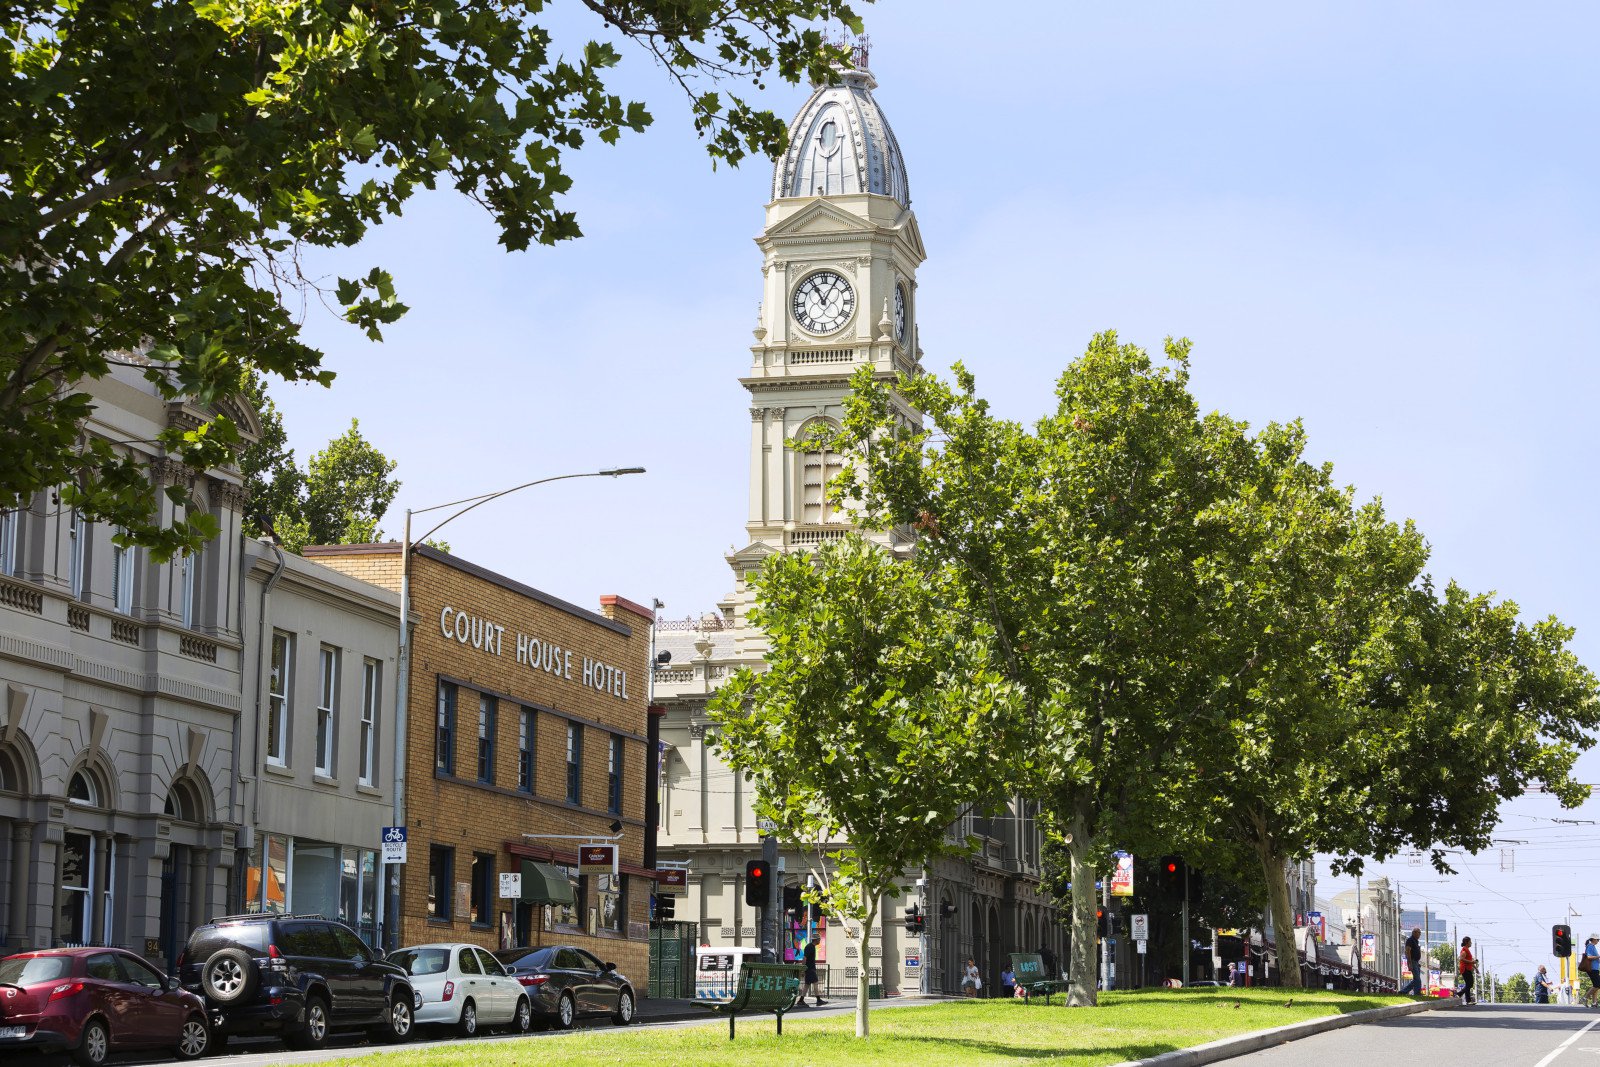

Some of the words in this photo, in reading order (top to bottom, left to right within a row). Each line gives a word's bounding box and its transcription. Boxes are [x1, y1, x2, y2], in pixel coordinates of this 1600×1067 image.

[440, 606, 505, 656] COURT
[516, 633, 572, 680] HOUSE
[582, 656, 629, 700] HOTEL
[147, 941, 158, 951] 94
